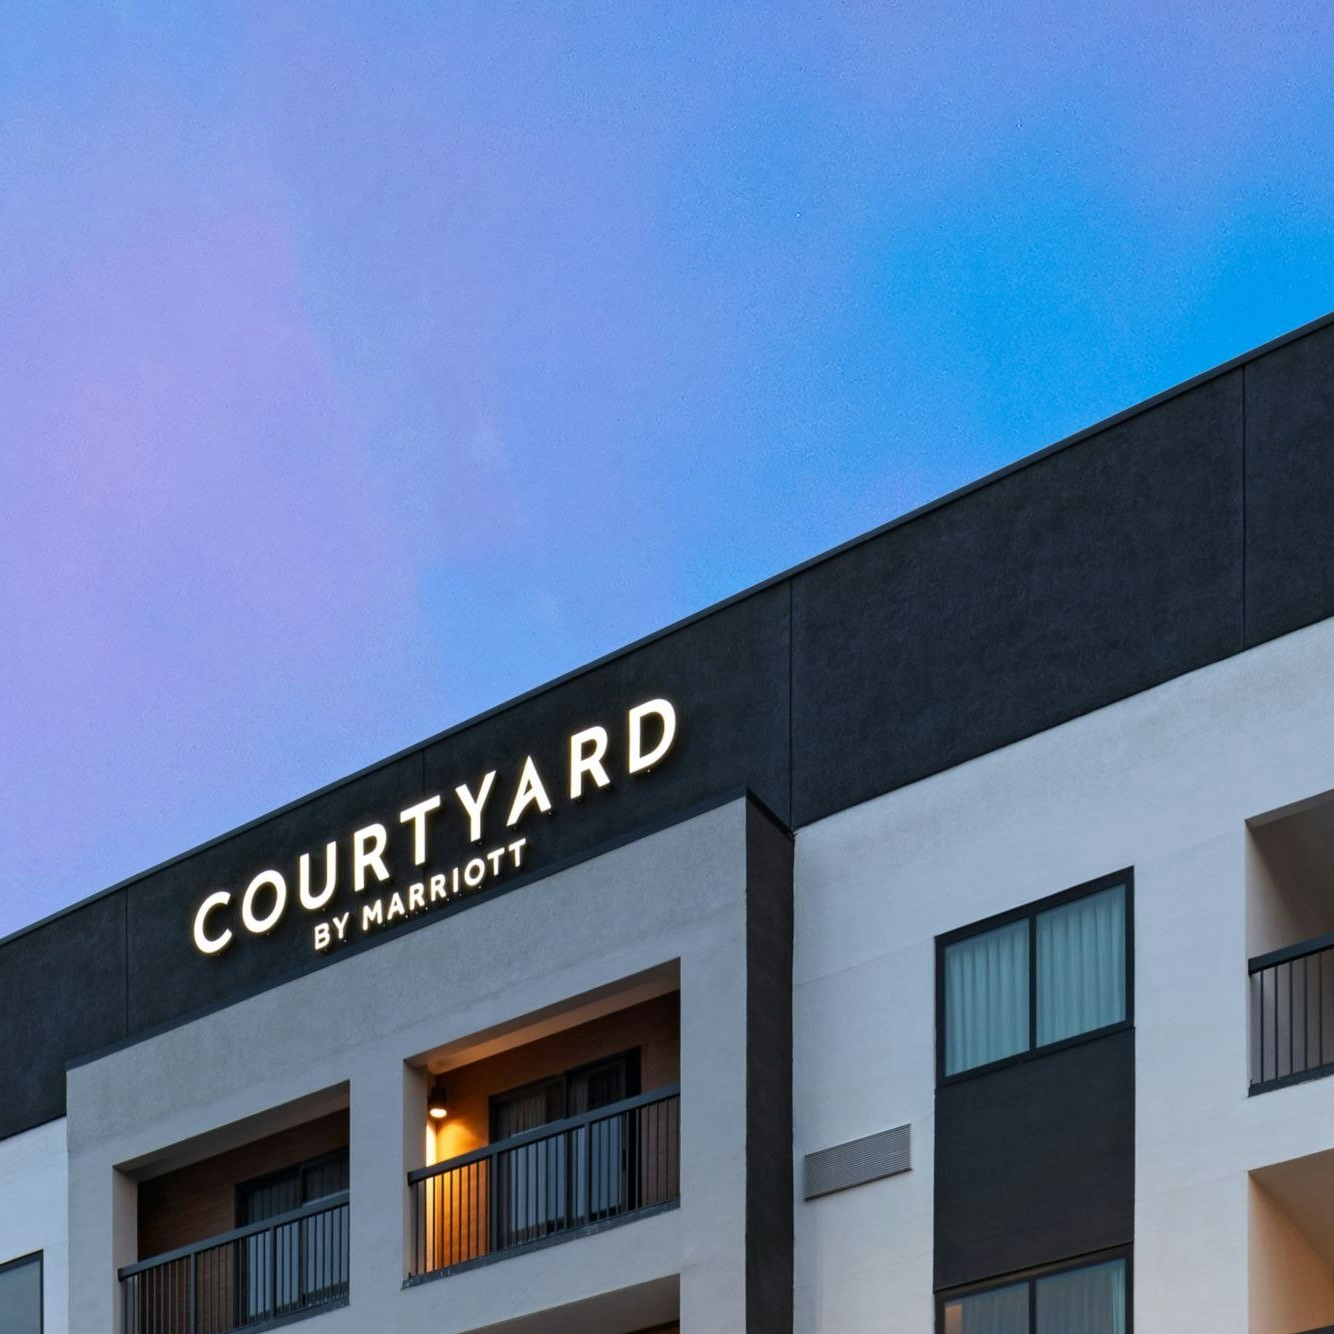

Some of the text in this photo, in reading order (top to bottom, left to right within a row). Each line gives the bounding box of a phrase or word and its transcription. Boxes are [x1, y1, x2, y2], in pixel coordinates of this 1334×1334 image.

[193, 698, 677, 955] COURTYARD
[313, 837, 527, 951] BY MARRIOTT
